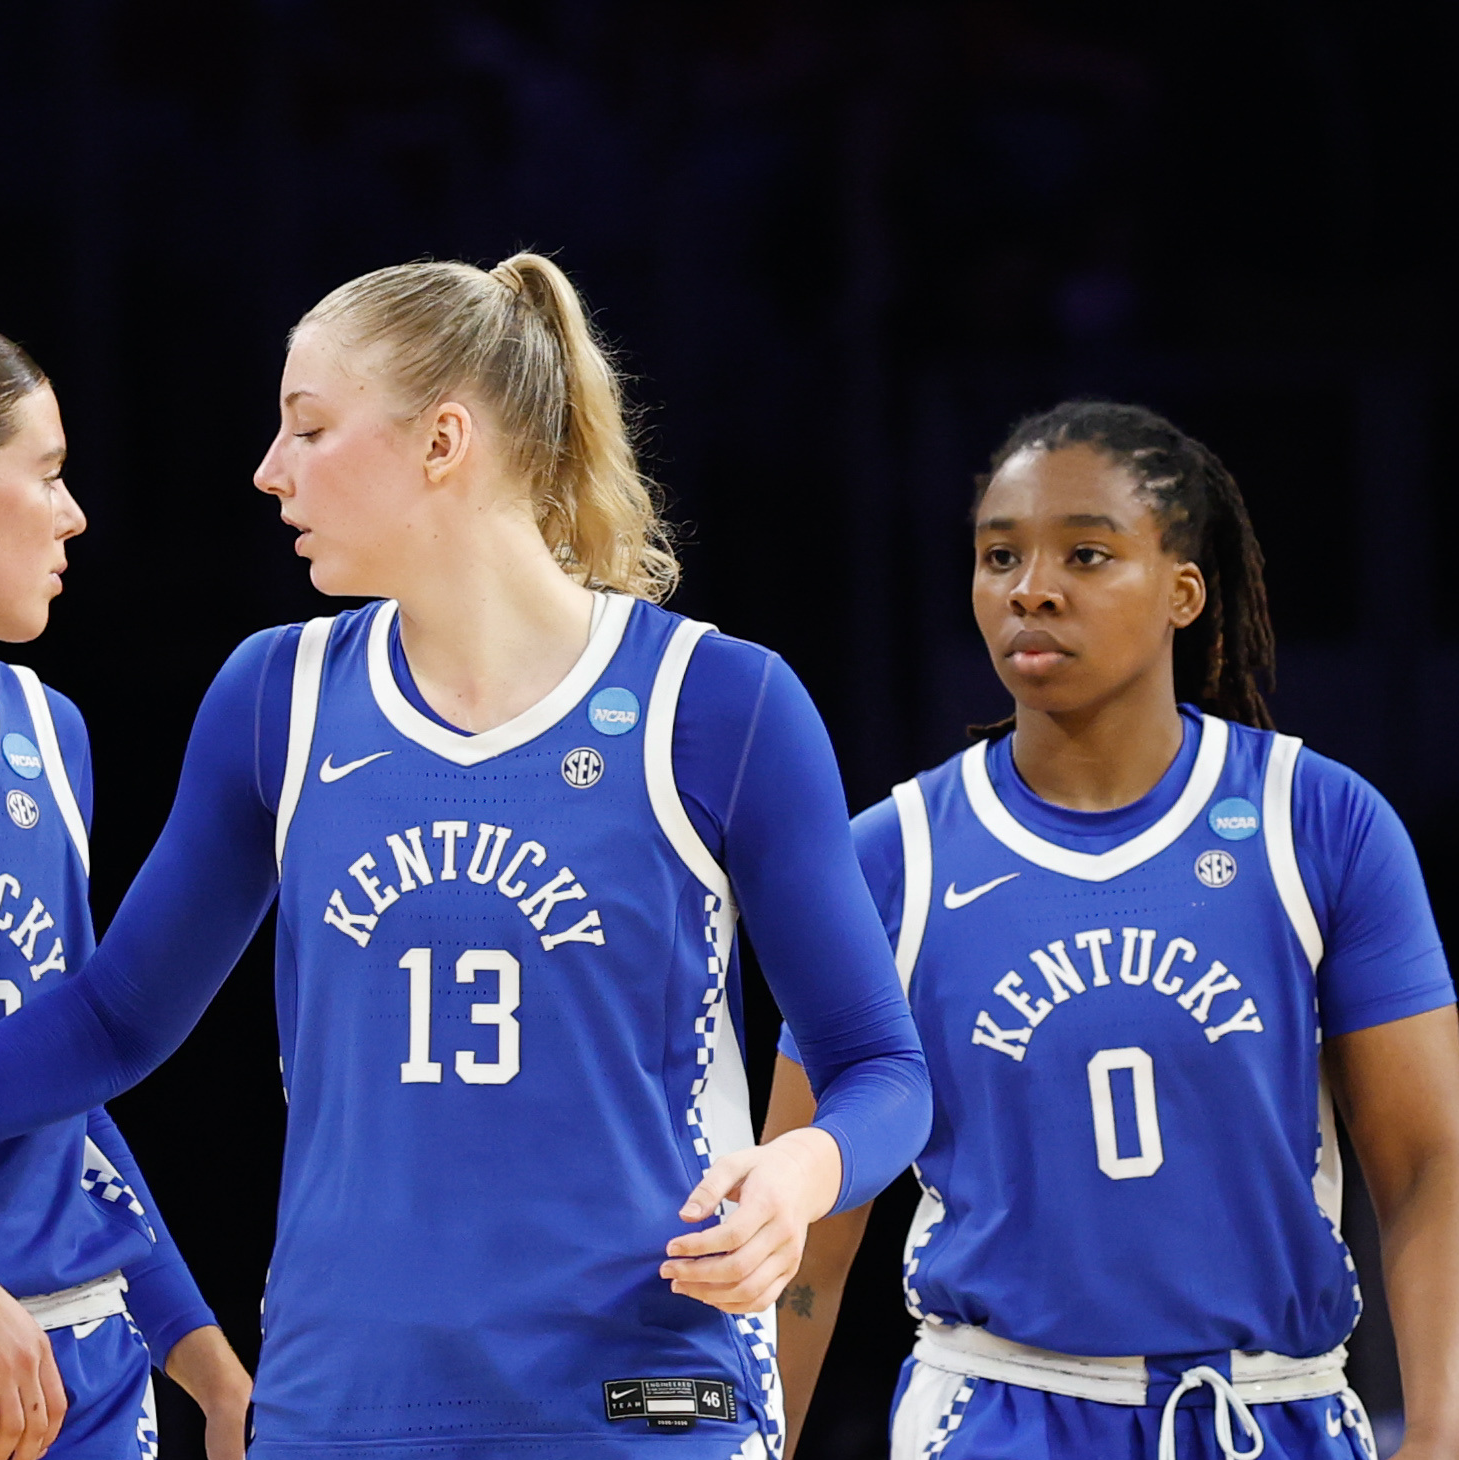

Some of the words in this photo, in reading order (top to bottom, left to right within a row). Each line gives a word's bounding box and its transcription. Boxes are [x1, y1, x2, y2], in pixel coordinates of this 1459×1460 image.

[594, 708, 636, 725] NCAA
[10, 753, 42, 768] NCAA
[564, 750, 601, 786] SEC
[8, 792, 37, 826] SEC
[1216, 816, 1258, 829] NCAA
[1198, 853, 1234, 885] SEC
[323, 820, 606, 952] KENTUCKY
[971, 927, 1264, 1062] KENTUCKY
[397, 947, 521, 1085] 13
[1086, 1046, 1164, 1181] 0
[611, 1401, 641, 1410] TEAM
[701, 1390, 721, 1408] 46
